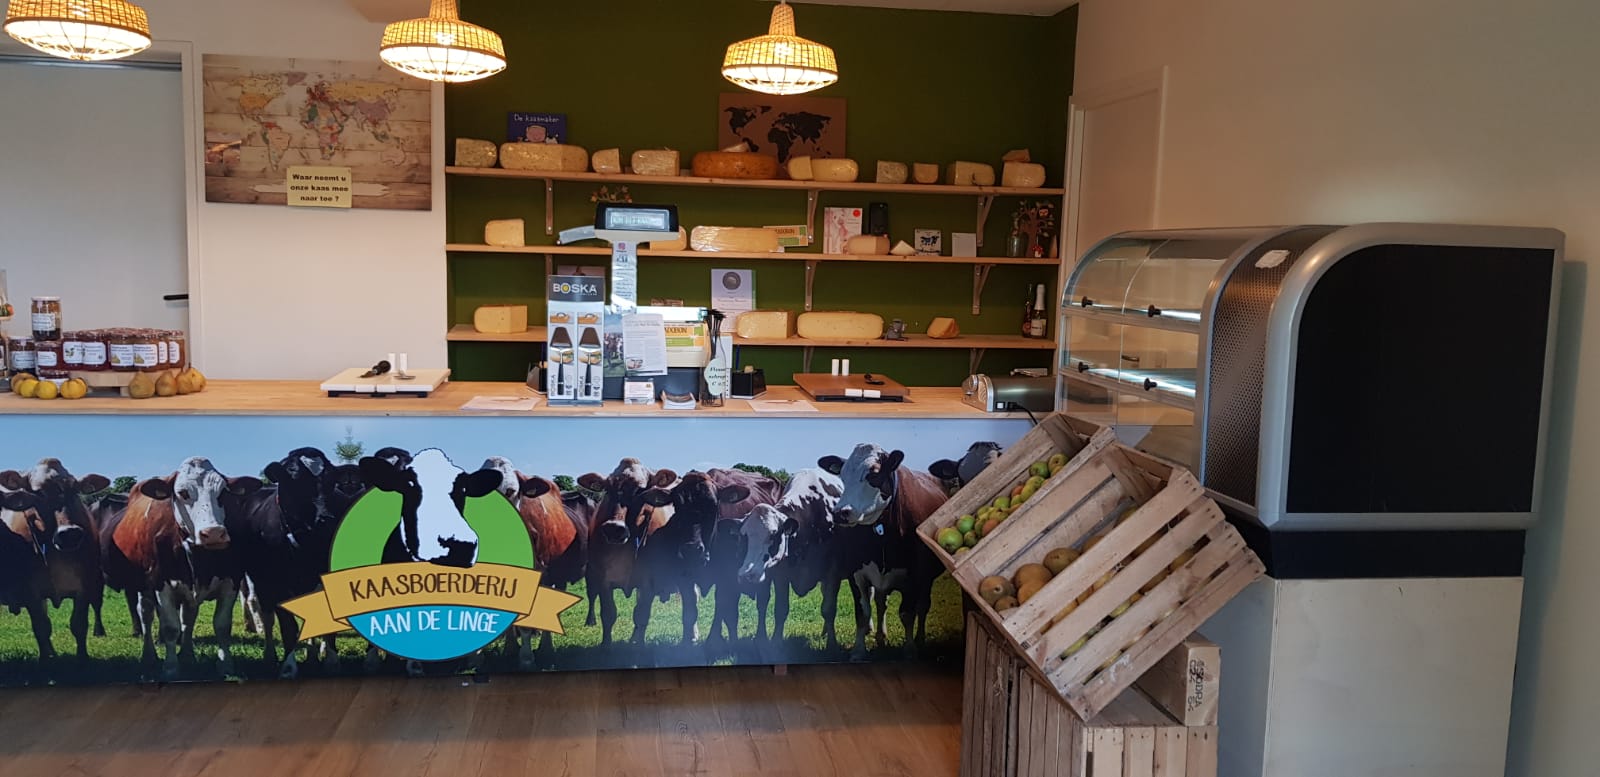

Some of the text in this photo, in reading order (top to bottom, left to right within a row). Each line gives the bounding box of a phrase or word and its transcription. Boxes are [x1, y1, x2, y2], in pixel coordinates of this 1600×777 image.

[552, 282, 598, 294] BOSKA
[349, 572, 518, 602] KAASBOERDERIJ
[369, 610, 500, 637] AAN DE LINGE
